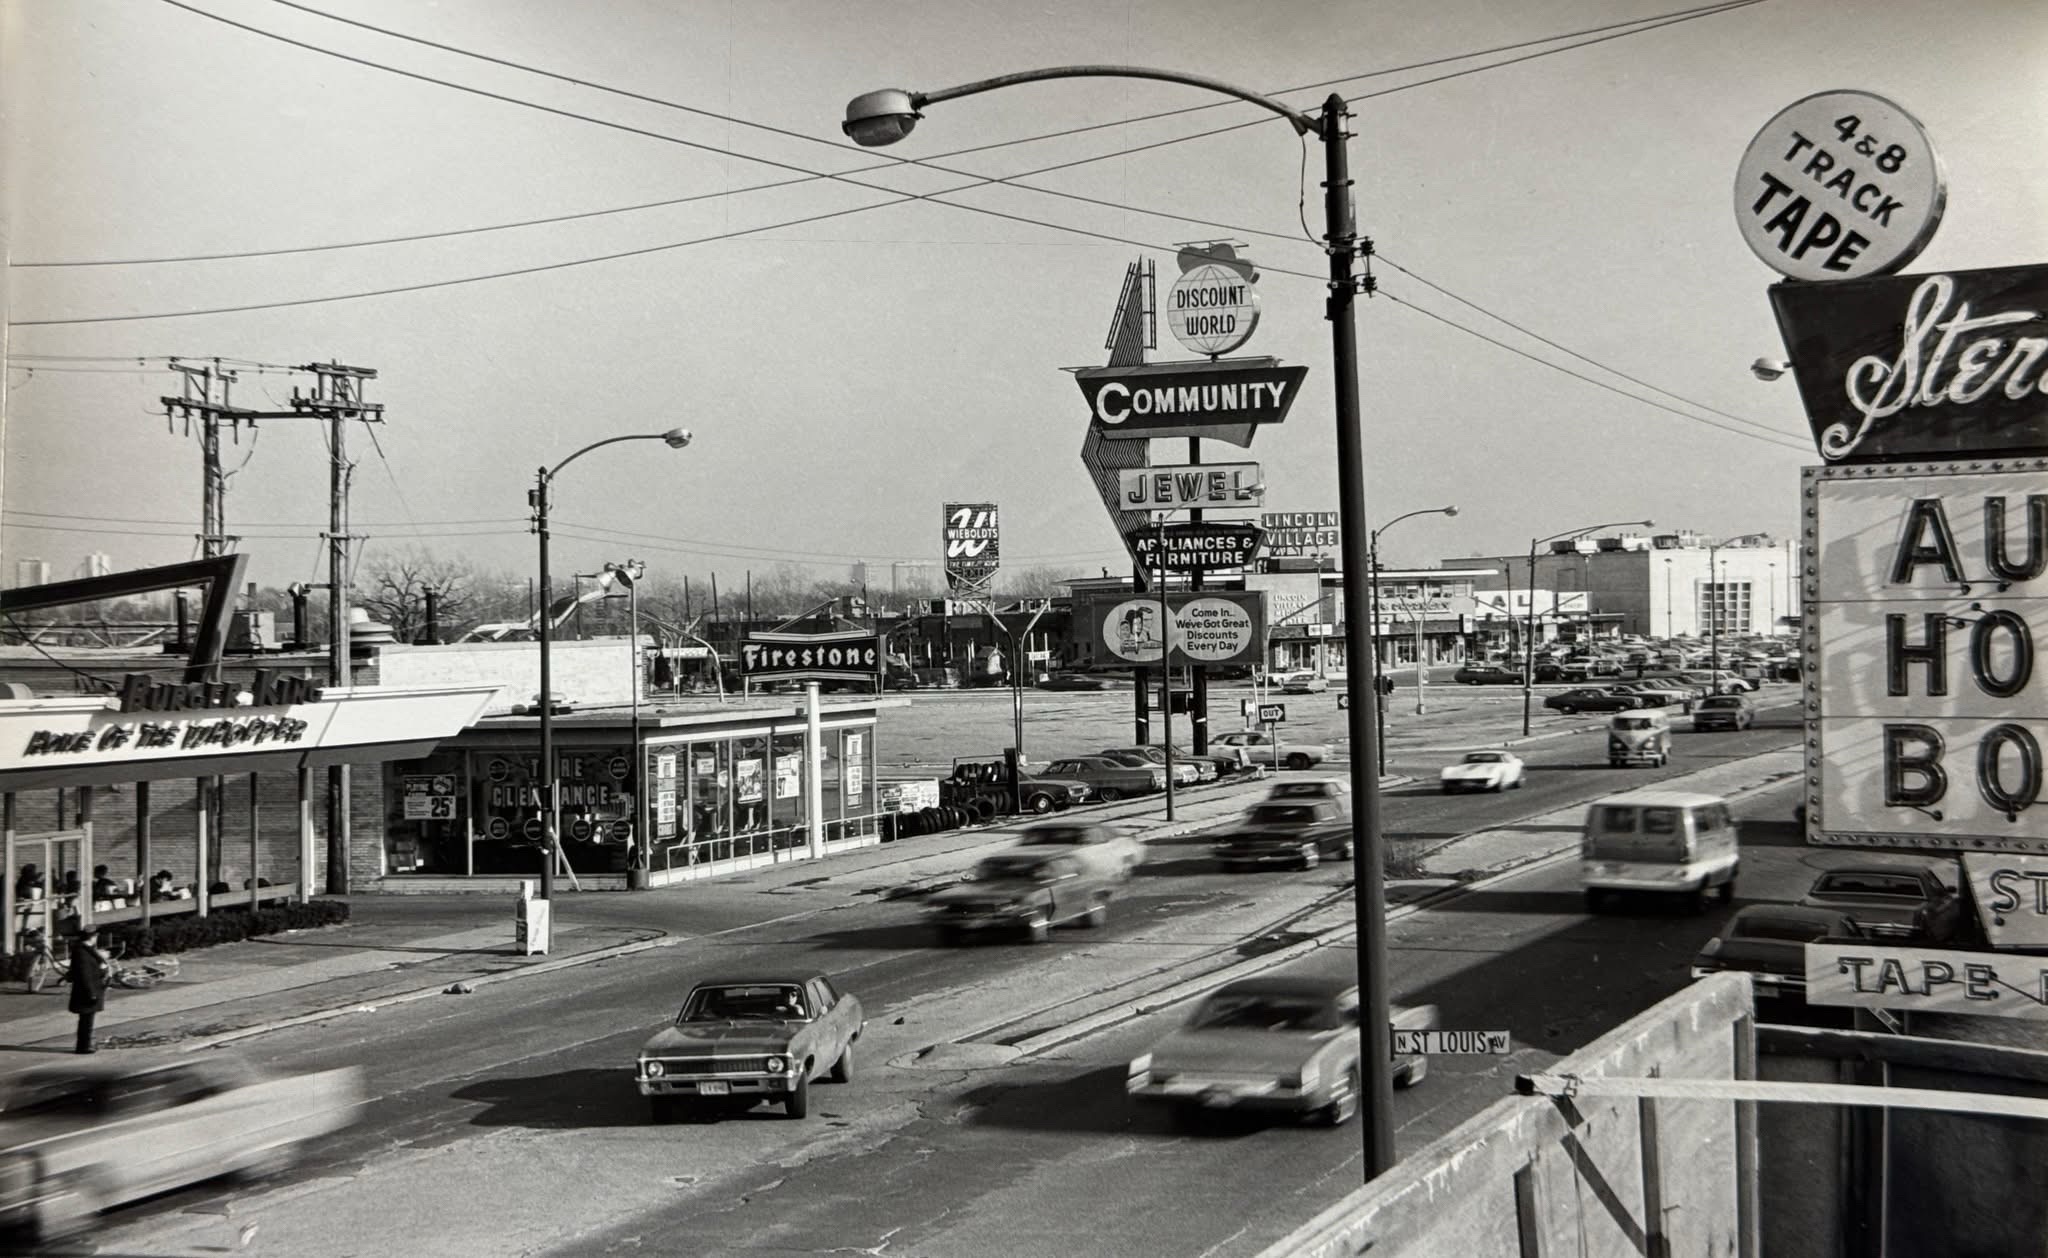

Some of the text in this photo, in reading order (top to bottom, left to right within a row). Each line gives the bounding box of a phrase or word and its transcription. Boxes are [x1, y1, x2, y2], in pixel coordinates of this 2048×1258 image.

[1783, 131, 1905, 228] TRACK
[1752, 171, 1871, 272] TAPE
[1177, 285, 1246, 309] DISCOUNT
[1186, 314, 1236, 336] WORLD
[1821, 275, 2048, 460] Ster
[1096, 381, 1288, 425] COMMUNITY
[1128, 471, 1253, 504] JEWEL
[1265, 513, 1336, 527] LINCOLN
[1242, 537, 1254, 548] &
[1266, 531, 1335, 545] VILLAGE
[1889, 494, 2048, 585] AU
[1191, 608, 1219, 617] Come
[1203, 619, 1221, 629] Got
[1221, 619, 1250, 628] Great
[1187, 630, 1239, 640] Discounts
[1187, 641, 1239, 653] Every Day
[742, 643, 876, 671] Firestone
[1885, 609, 2035, 698] HO
[1263, 709, 1280, 718] OUT
[530, 758, 584, 777] TRE
[1883, 723, 2044, 813] BO
[493, 784, 609, 808] CLEAANCE
[1837, 956, 1995, 1002] TAPE
[1397, 1035, 1406, 1050] N
[1411, 1031, 1430, 1054] ST
[1439, 1031, 1486, 1053] LOUIS
